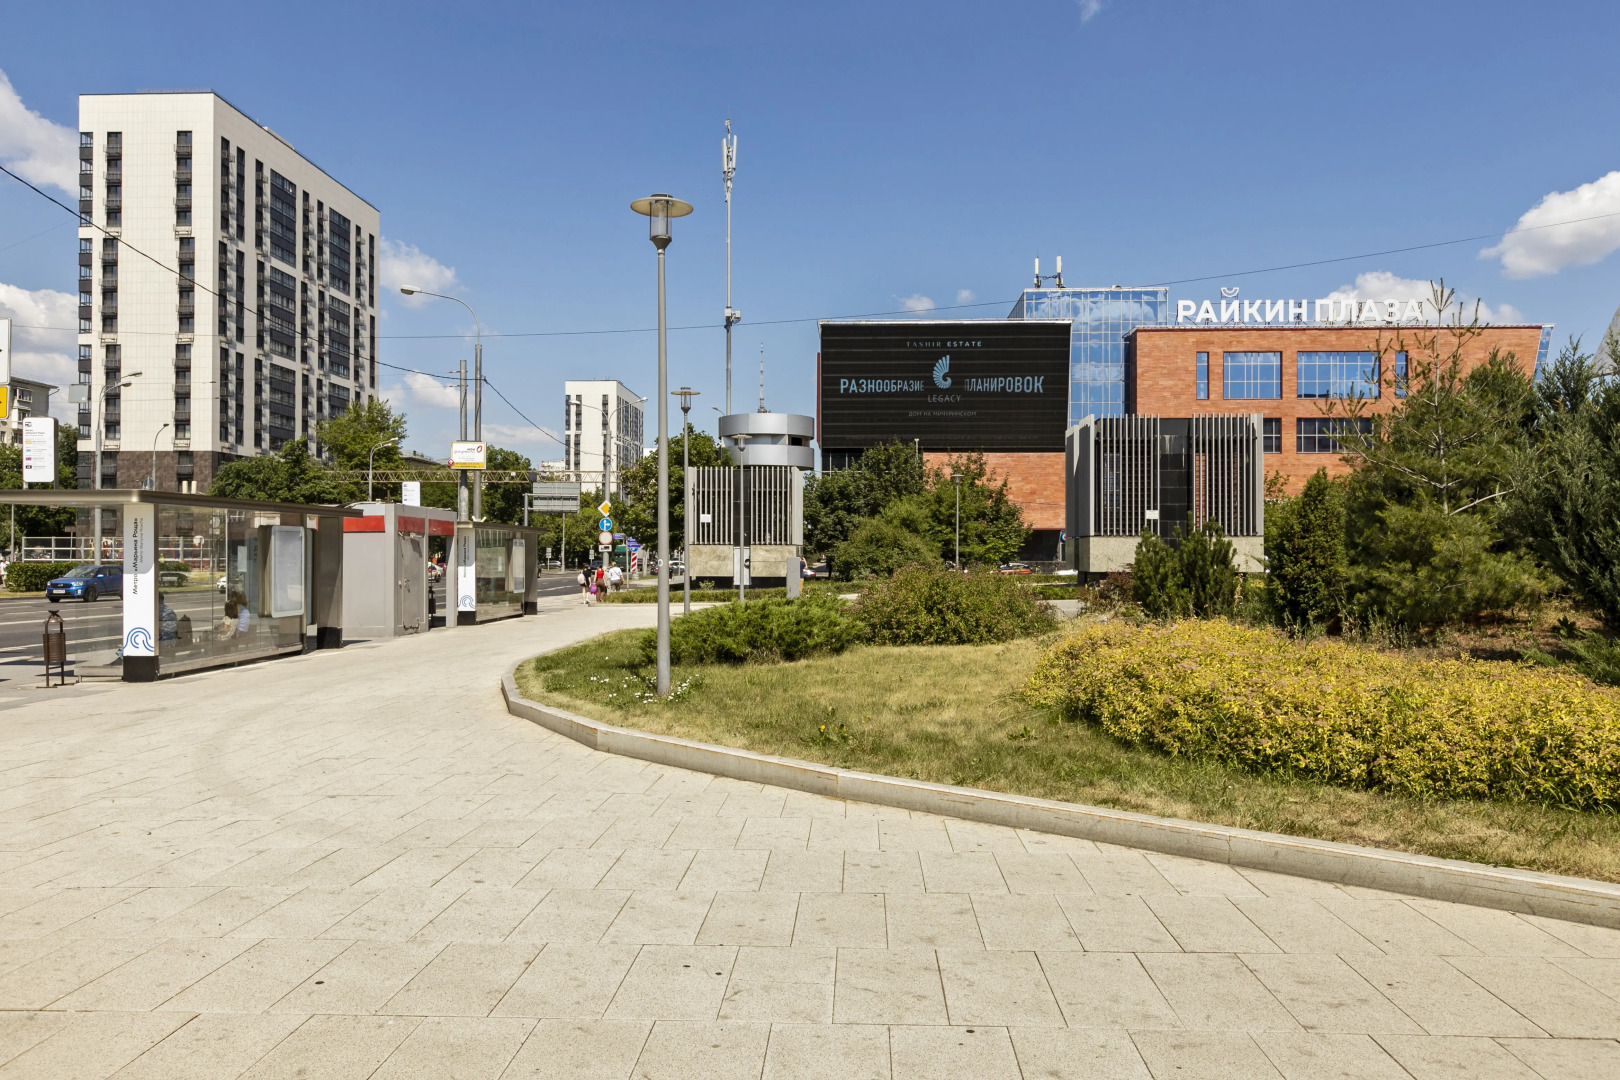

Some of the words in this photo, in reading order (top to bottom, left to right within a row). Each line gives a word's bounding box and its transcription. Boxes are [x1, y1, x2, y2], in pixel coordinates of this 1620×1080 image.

[1177, 287, 1307, 322] РАЙКИН
[1315, 299, 1423, 322] ПЛАЗА
[840, 378, 925, 394] РАЗНООБРАЗИЕ
[964, 375, 1045, 393] ПЛАНИРОВОК
[927, 394, 961, 403] LEGACY
